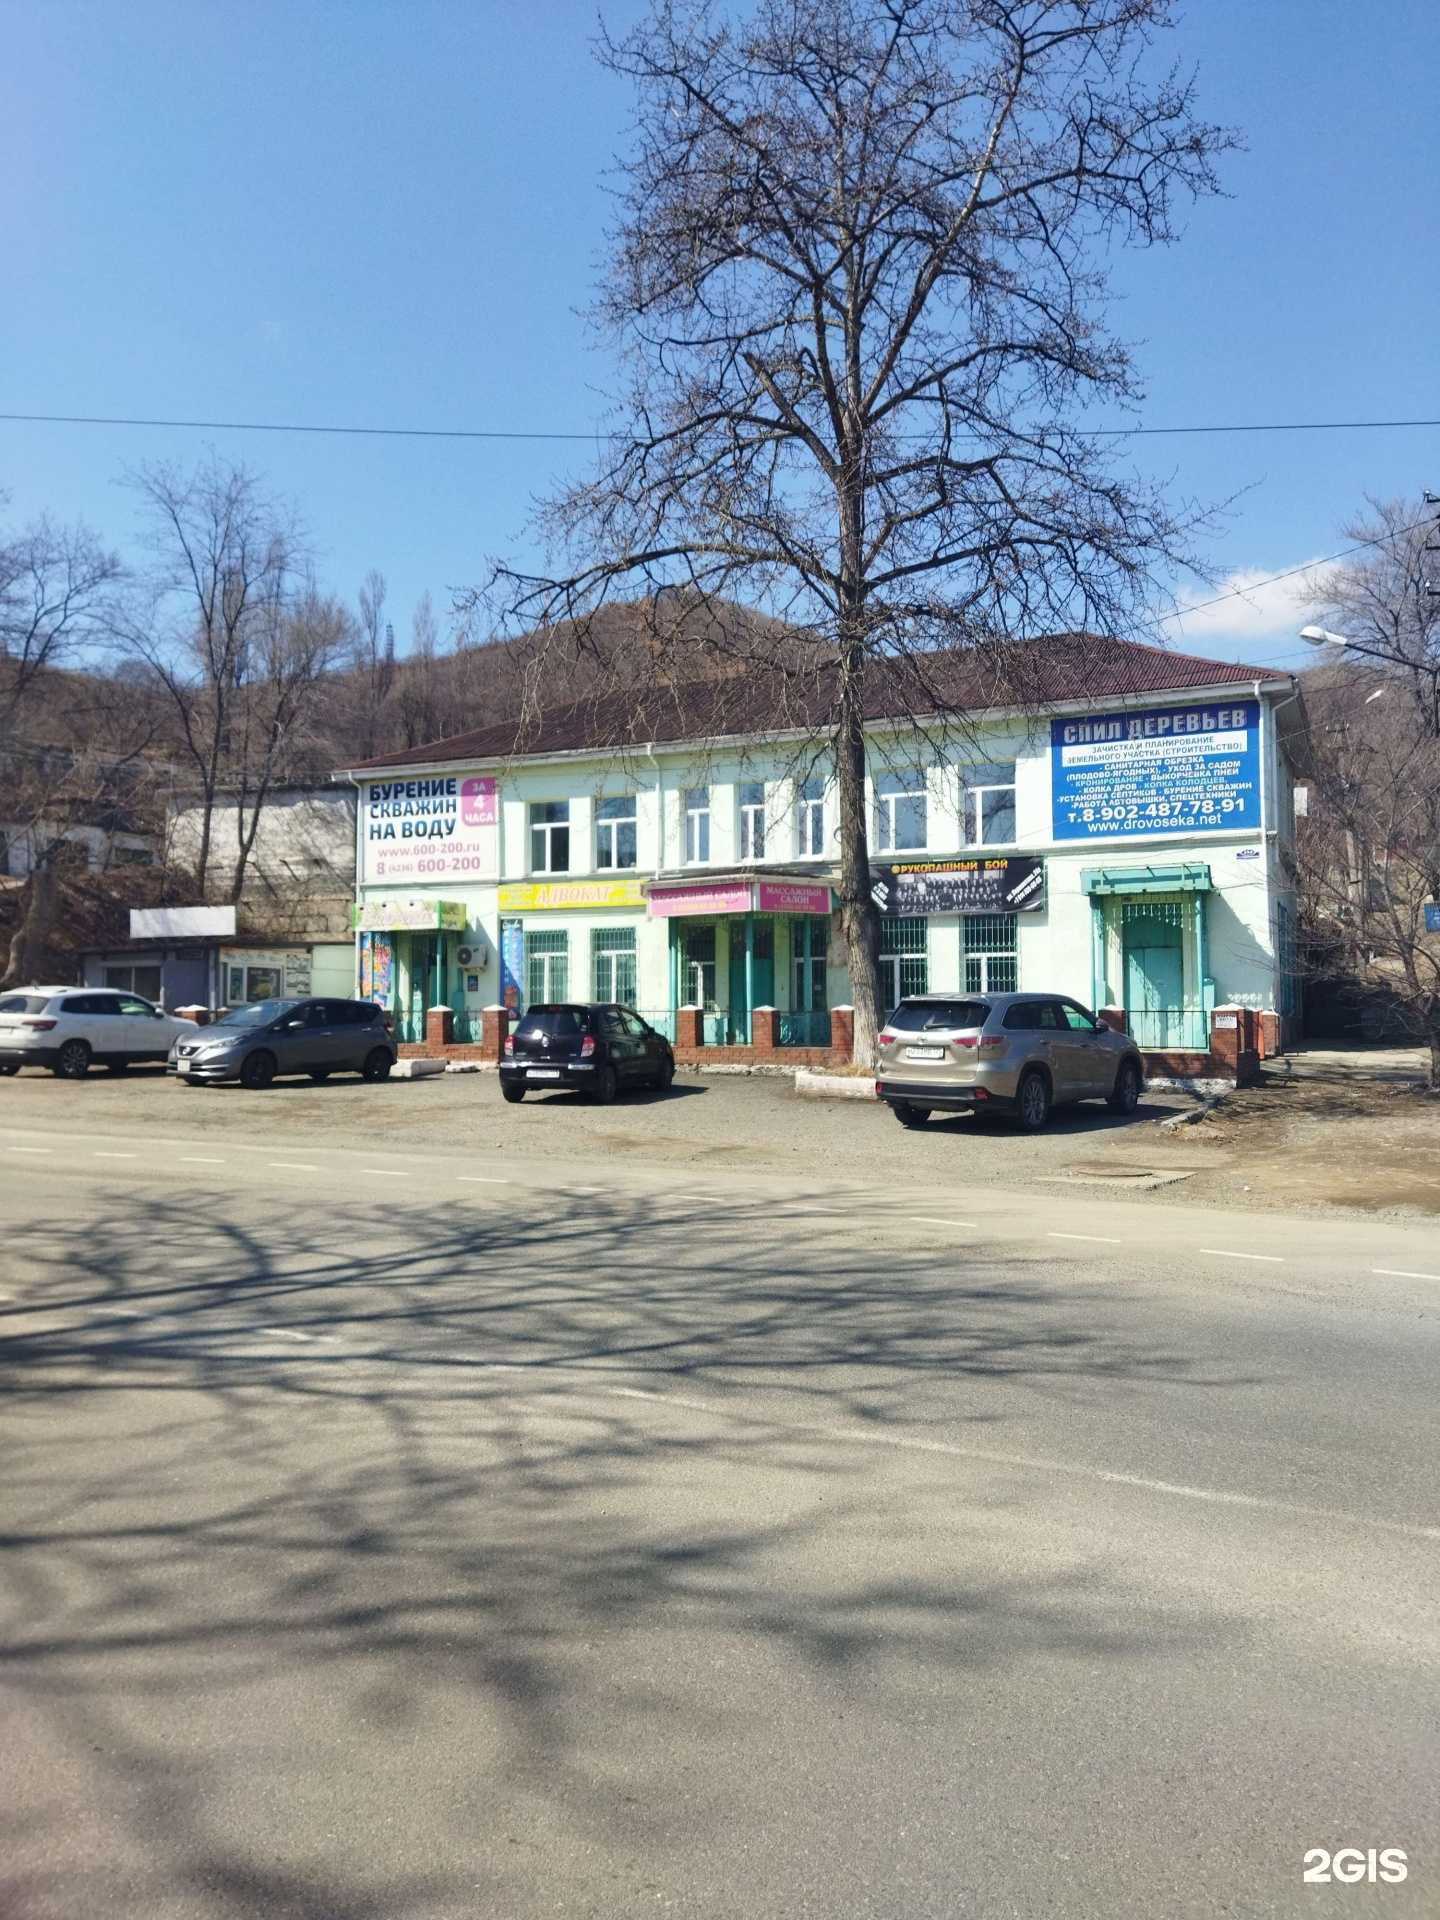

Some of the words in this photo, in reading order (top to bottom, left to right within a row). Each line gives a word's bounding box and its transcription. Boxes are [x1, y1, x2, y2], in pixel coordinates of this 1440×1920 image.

[1063, 722, 1121, 743] СПИЛ
[1128, 709, 1247, 741] ДЕРЕВЬЕВ
[1067, 753, 1121, 764] ЗЕМЕЛЬНОГО
[1123, 749, 1161, 760] УЧАСТКА
[1162, 742, 1242, 756] (СТРОИТЕЛЬСТВО)
[1092, 743, 1135, 754] ЗАЧИСТКА
[1145, 736, 1214, 749] ПЛАНИРОВАНИЕ
[1104, 759, 1162, 770] САНИТАРНАЯ
[1164, 755, 1205, 766] ОБРЕЗКА
[1168, 764, 1192, 773] УХОД
[1208, 760, 1241, 769] САДОМ
[1075, 776, 1144, 787] КРОНИРОВАНИЕ
[1151, 770, 1211, 781] ВЫКОРЧЕВКА
[1214, 767, 1239, 776] ПНЕЙ
[369, 778, 457, 802] БУРЕНИЕ
[472, 782, 486, 792] ЗА
[1084, 785, 1111, 794] КОЛКА
[1114, 782, 1137, 792] ДРОВ
[1144, 779, 1173, 789] КОПКА
[1111, 788, 1157, 799] СЕПТИКОВ
[1164, 784, 1204, 795] БУРЕНИЕ
[1206, 781, 1252, 792] СКВАЖИН
[473, 795, 485, 809] 4
[1170, 791, 1237, 802] СПЕЦТЕХНИКИ
[370, 798, 457, 819] СКВАЖИН
[464, 811, 495, 821] ЧАСА
[370, 823, 396, 840] НА
[401, 818, 457, 840] ВОДУ
[1088, 812, 1222, 832] www.drovoseka.net
[377, 842, 480, 858] www.600-200.ru
[376, 862, 386, 875] 8
[417, 856, 481, 873] 600-200
[900, 861, 978, 874] РУКОПАШНЫЙ
[985, 859, 1008, 870] БОЙ
[535, 886, 612, 904] АДВОКАТ
[766, 886, 823, 897] МАССАЖНЫЙ
[780, 895, 810, 904] САЛОН
